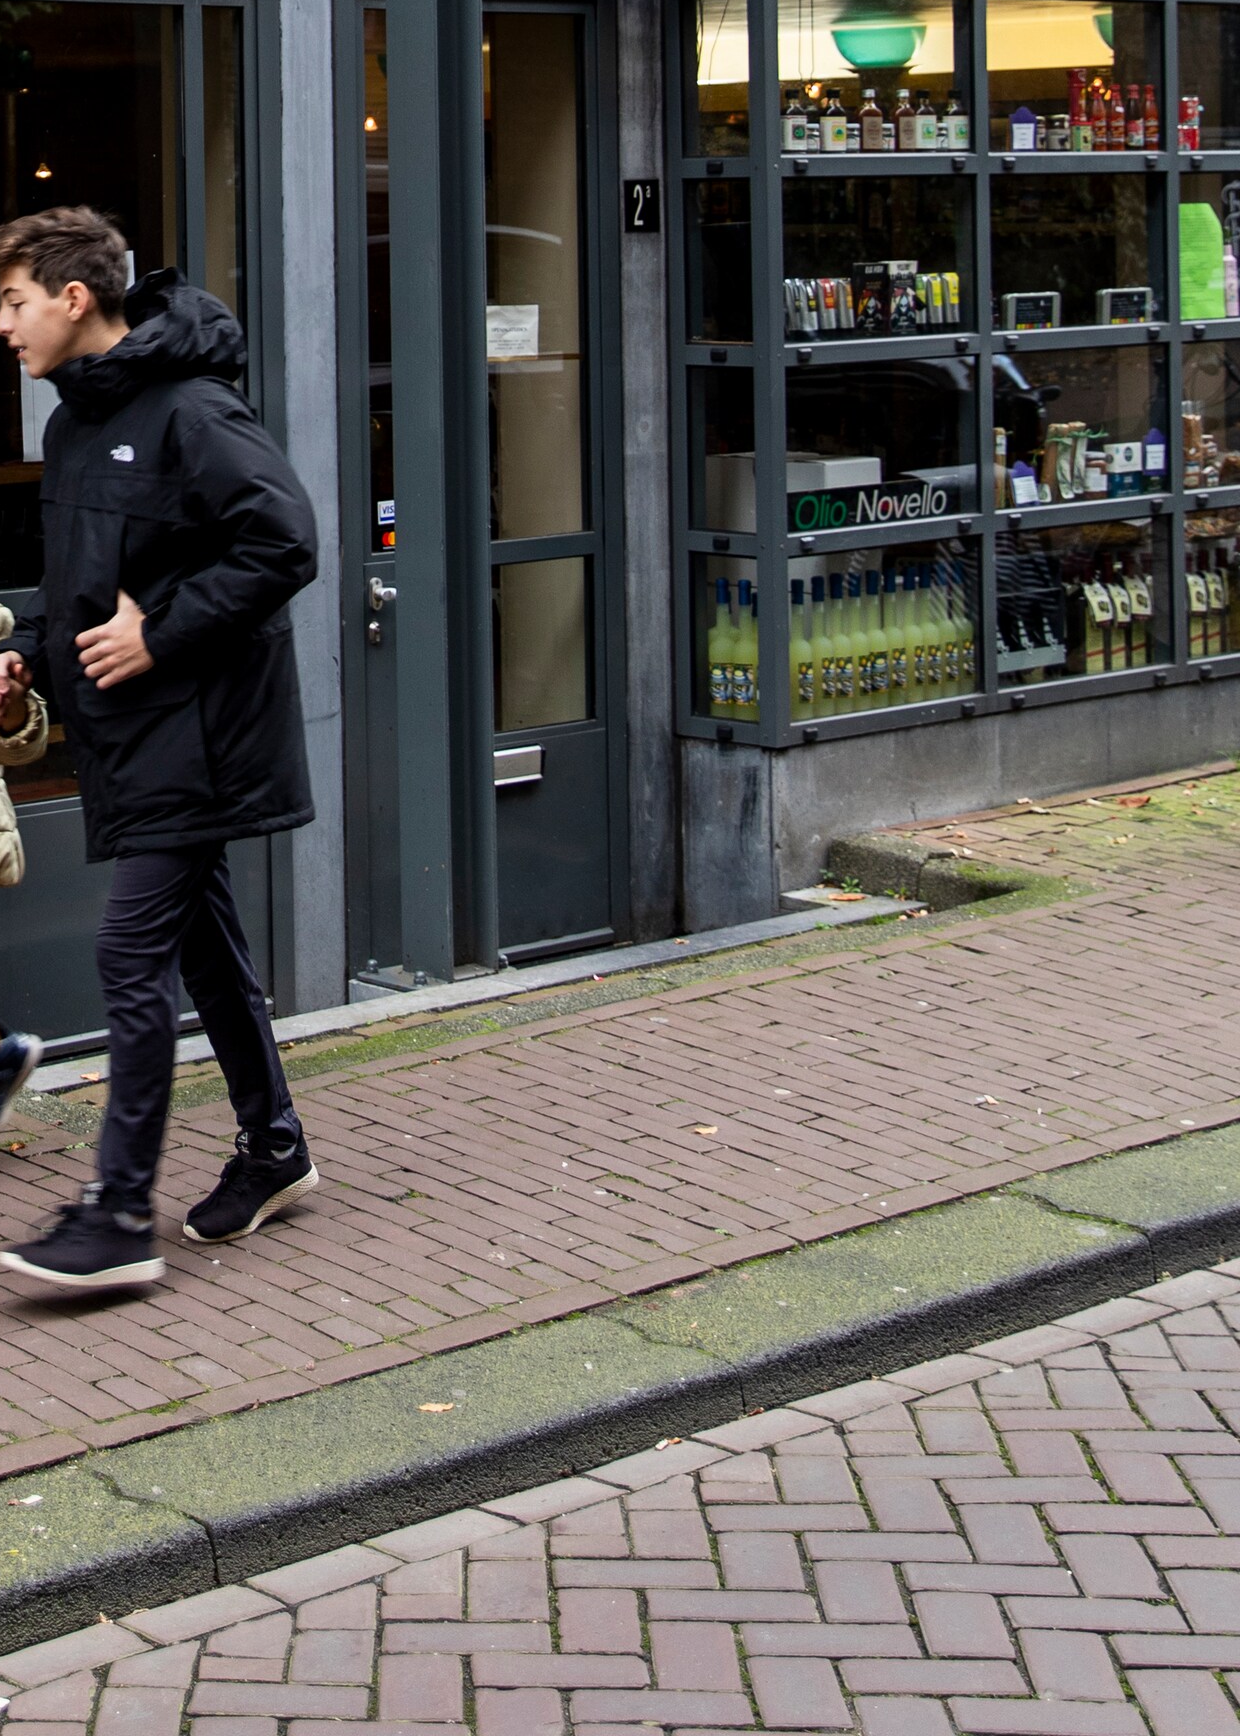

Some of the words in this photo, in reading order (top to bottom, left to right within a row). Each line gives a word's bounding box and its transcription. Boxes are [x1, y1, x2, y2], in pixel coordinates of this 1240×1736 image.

[382, 505, 395, 515] VIS
[795, 494, 847, 530] Olio
[856, 483, 947, 523] Novello
